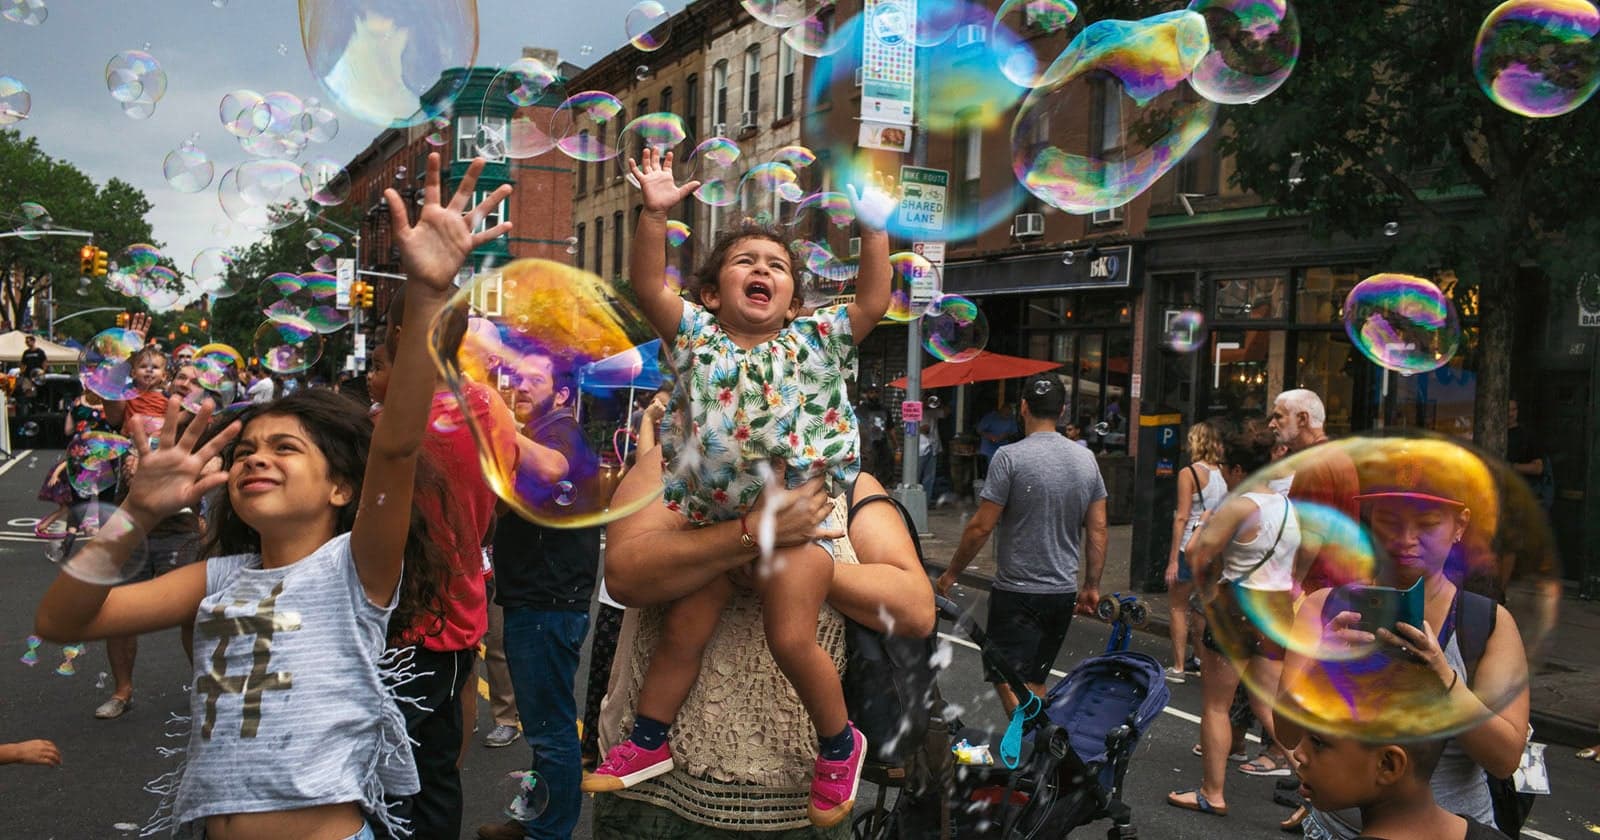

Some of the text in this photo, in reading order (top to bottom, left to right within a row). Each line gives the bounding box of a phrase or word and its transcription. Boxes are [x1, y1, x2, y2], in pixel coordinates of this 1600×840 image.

[923, 172, 946, 183] ROUTE
[901, 200, 943, 213] SHARED
[906, 212, 936, 224] LANE
[1162, 427, 1174, 445] P
